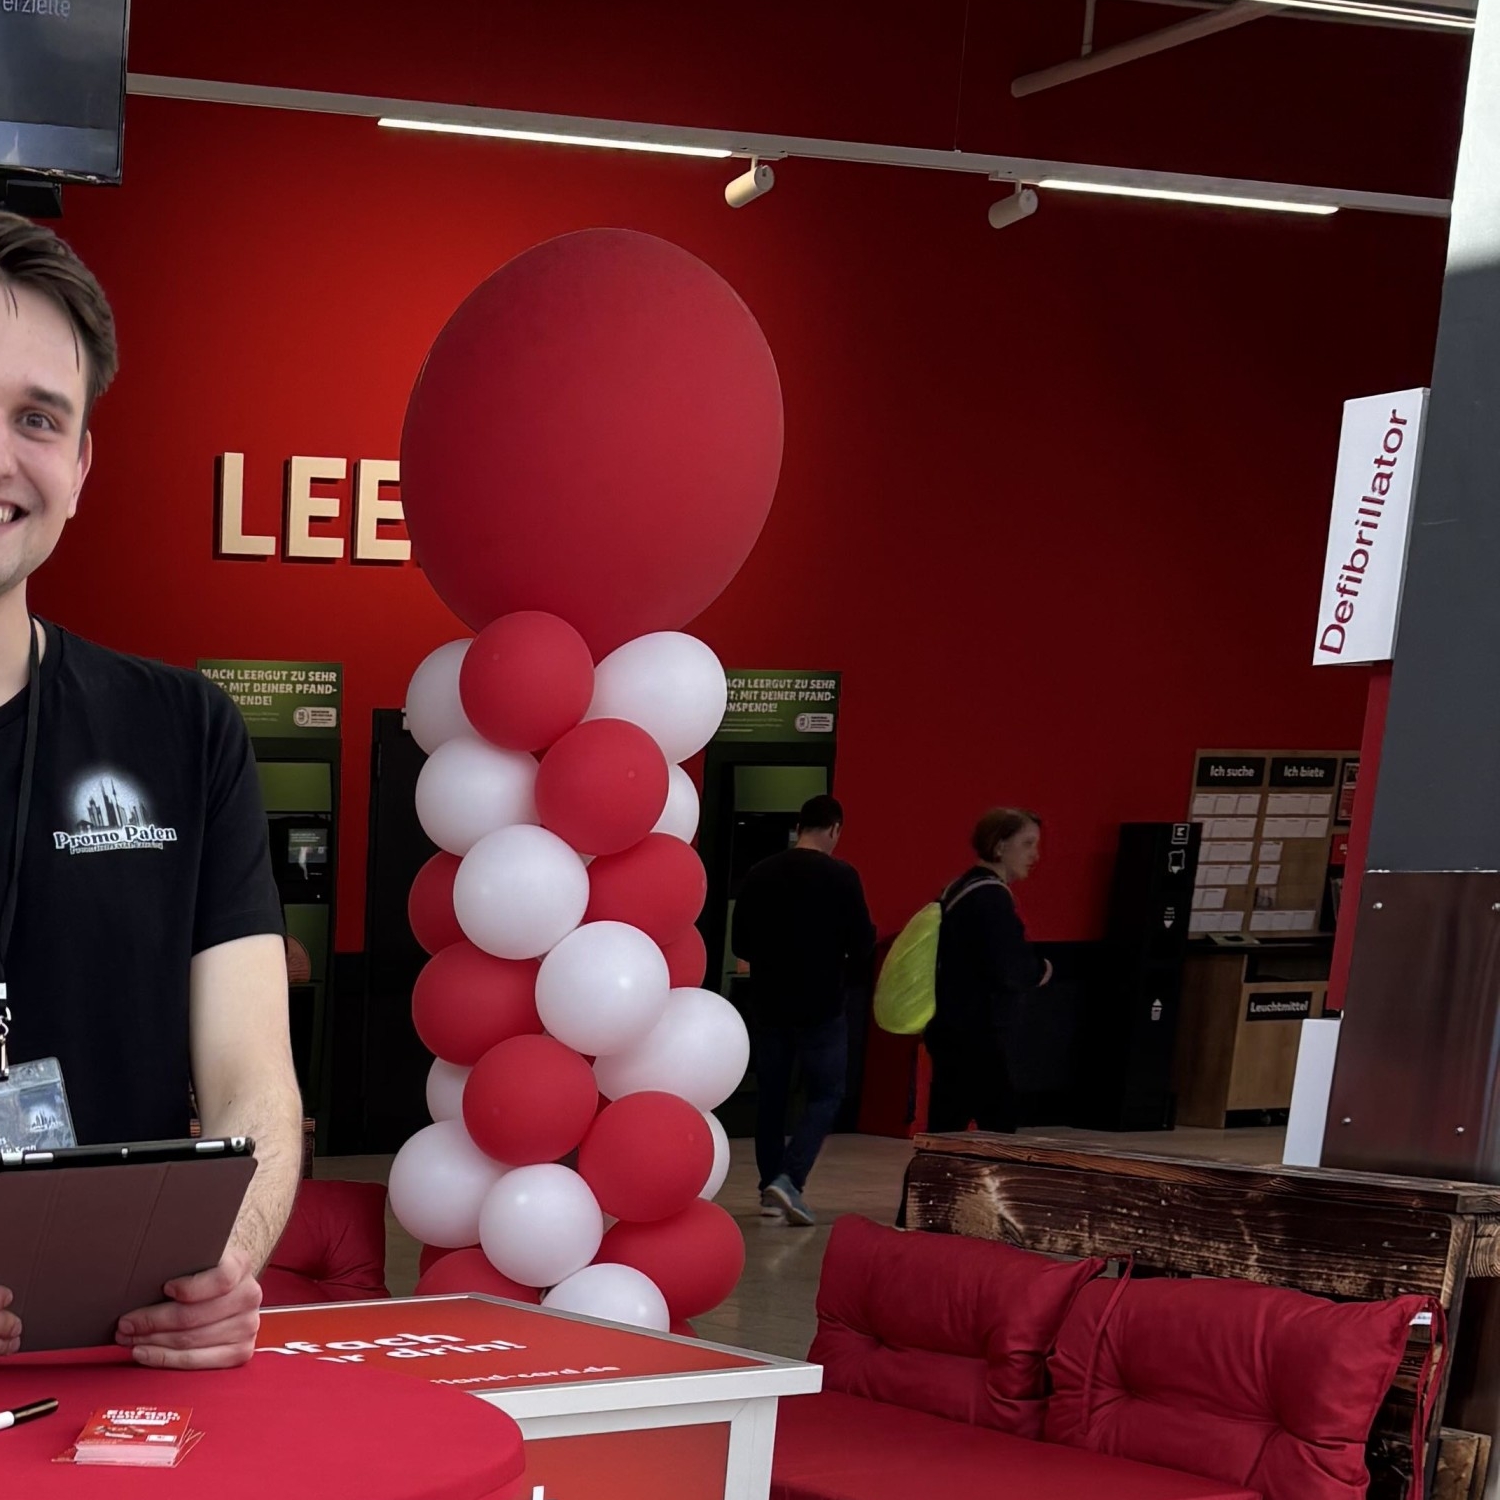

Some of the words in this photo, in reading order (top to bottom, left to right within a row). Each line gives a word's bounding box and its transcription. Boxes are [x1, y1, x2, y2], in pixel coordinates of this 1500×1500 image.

[217, 451, 412, 561] LEE
[1319, 408, 1408, 655] Defibrillator
[237, 670, 288, 681] LEERGUT
[290, 671, 305, 681] ZU
[308, 672, 337, 682] SEHR
[229, 682, 252, 693] MIT
[253, 683, 293, 694] DEINER
[295, 684, 337, 695] PFAND-
[810, 679, 836, 690] SEHR
[232, 695, 272, 706] PENDE!
[1210, 764, 1225, 777] Ich
[1226, 765, 1255, 777] suche
[53, 830, 120, 849] Promo
[123, 825, 177, 842] Paten
[1250, 1001, 1309, 1013] Leuchtmittel
[254, 1333, 465, 1355] fach
[386, 1340, 527, 1359] drin!
[431, 1365, 620, 1386] land-card.de
